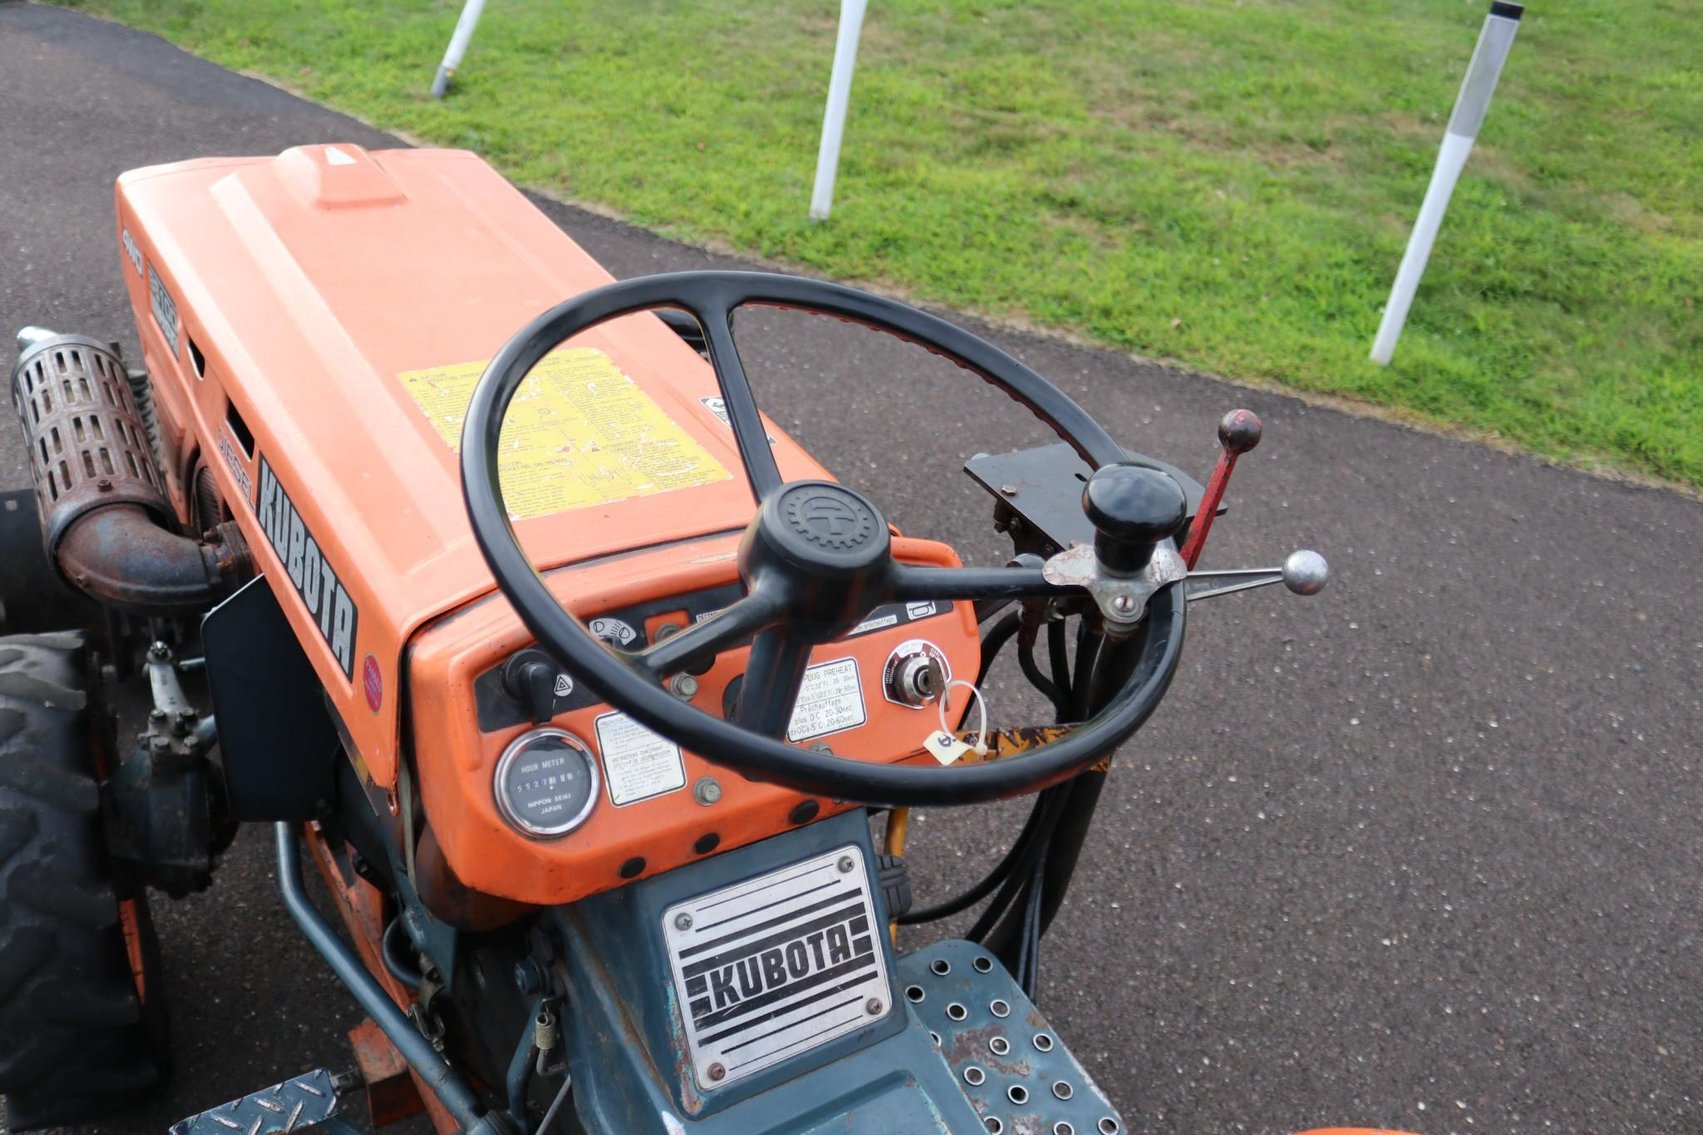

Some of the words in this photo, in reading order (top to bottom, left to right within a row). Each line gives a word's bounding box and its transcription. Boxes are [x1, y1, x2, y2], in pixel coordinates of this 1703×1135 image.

[259, 458, 354, 675] KUBOTA
[823, 664, 852, 676] PREHEAT
[520, 763, 539, 775] HOUR
[541, 757, 565, 770] METER
[527, 797, 552, 809] NIPPON
[540, 804, 563, 815] JAPAN
[710, 923, 852, 1009] KUBOTA
